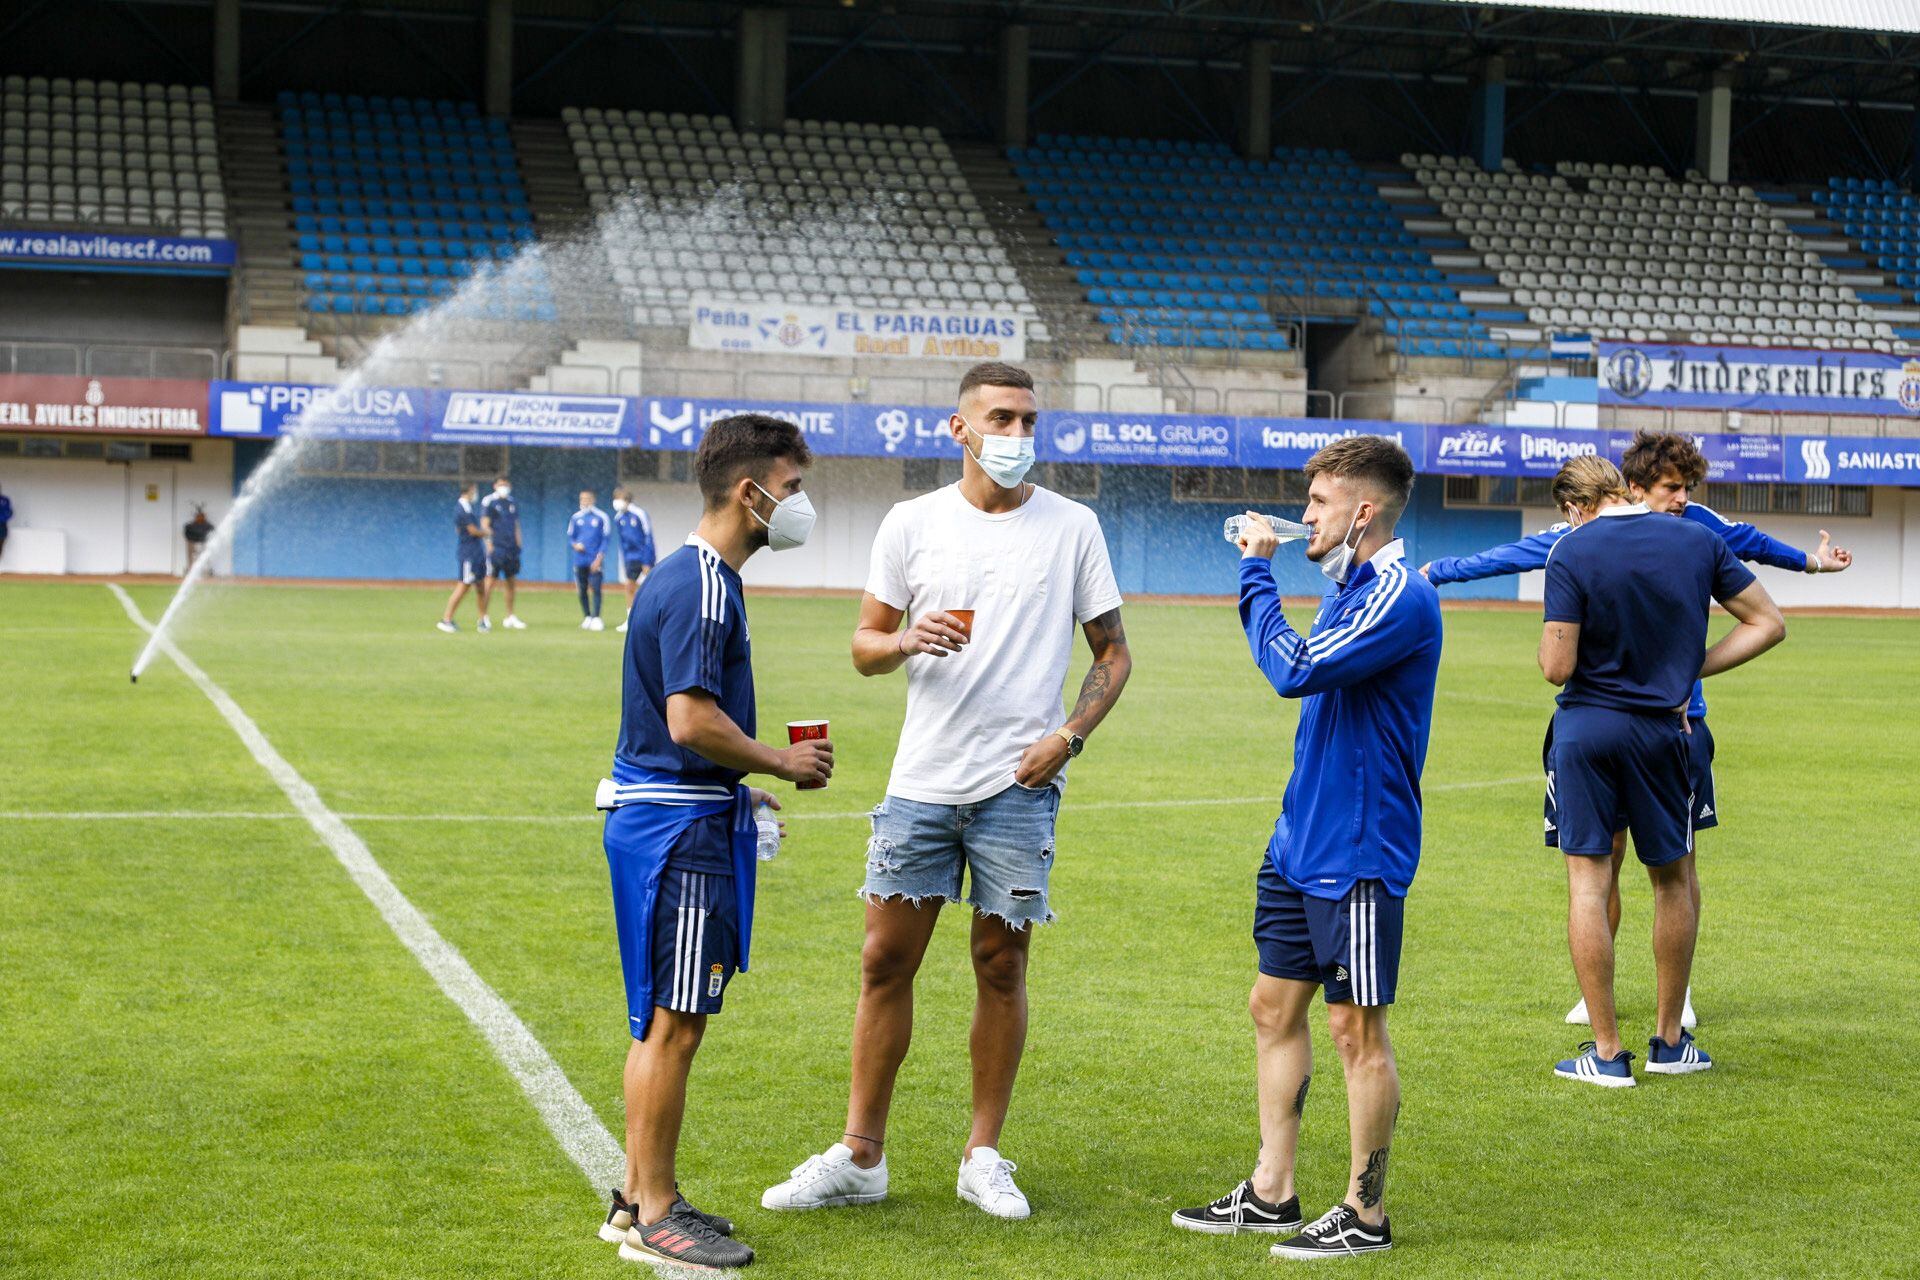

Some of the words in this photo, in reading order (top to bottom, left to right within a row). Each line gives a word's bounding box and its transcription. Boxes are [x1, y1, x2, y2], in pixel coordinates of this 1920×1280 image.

[696, 306, 750, 326] Peña
[836, 311, 864, 331] EL
[874, 314, 1015, 337] PARAGUAS
[1662, 349, 1885, 399] Indeseables
[512, 399, 555, 411] IRON
[35, 403, 97, 427] AVILES
[97, 405, 202, 431] INDUSTRIAL
[508, 415, 616, 429] MACHTRADE
[1091, 423, 1116, 441] EL
[1118, 424, 1158, 443] SOL
[1160, 424, 1229, 445] GRUPO
[1438, 432, 1507, 458] prink
[1091, 442, 1157, 456] CONSULTING
